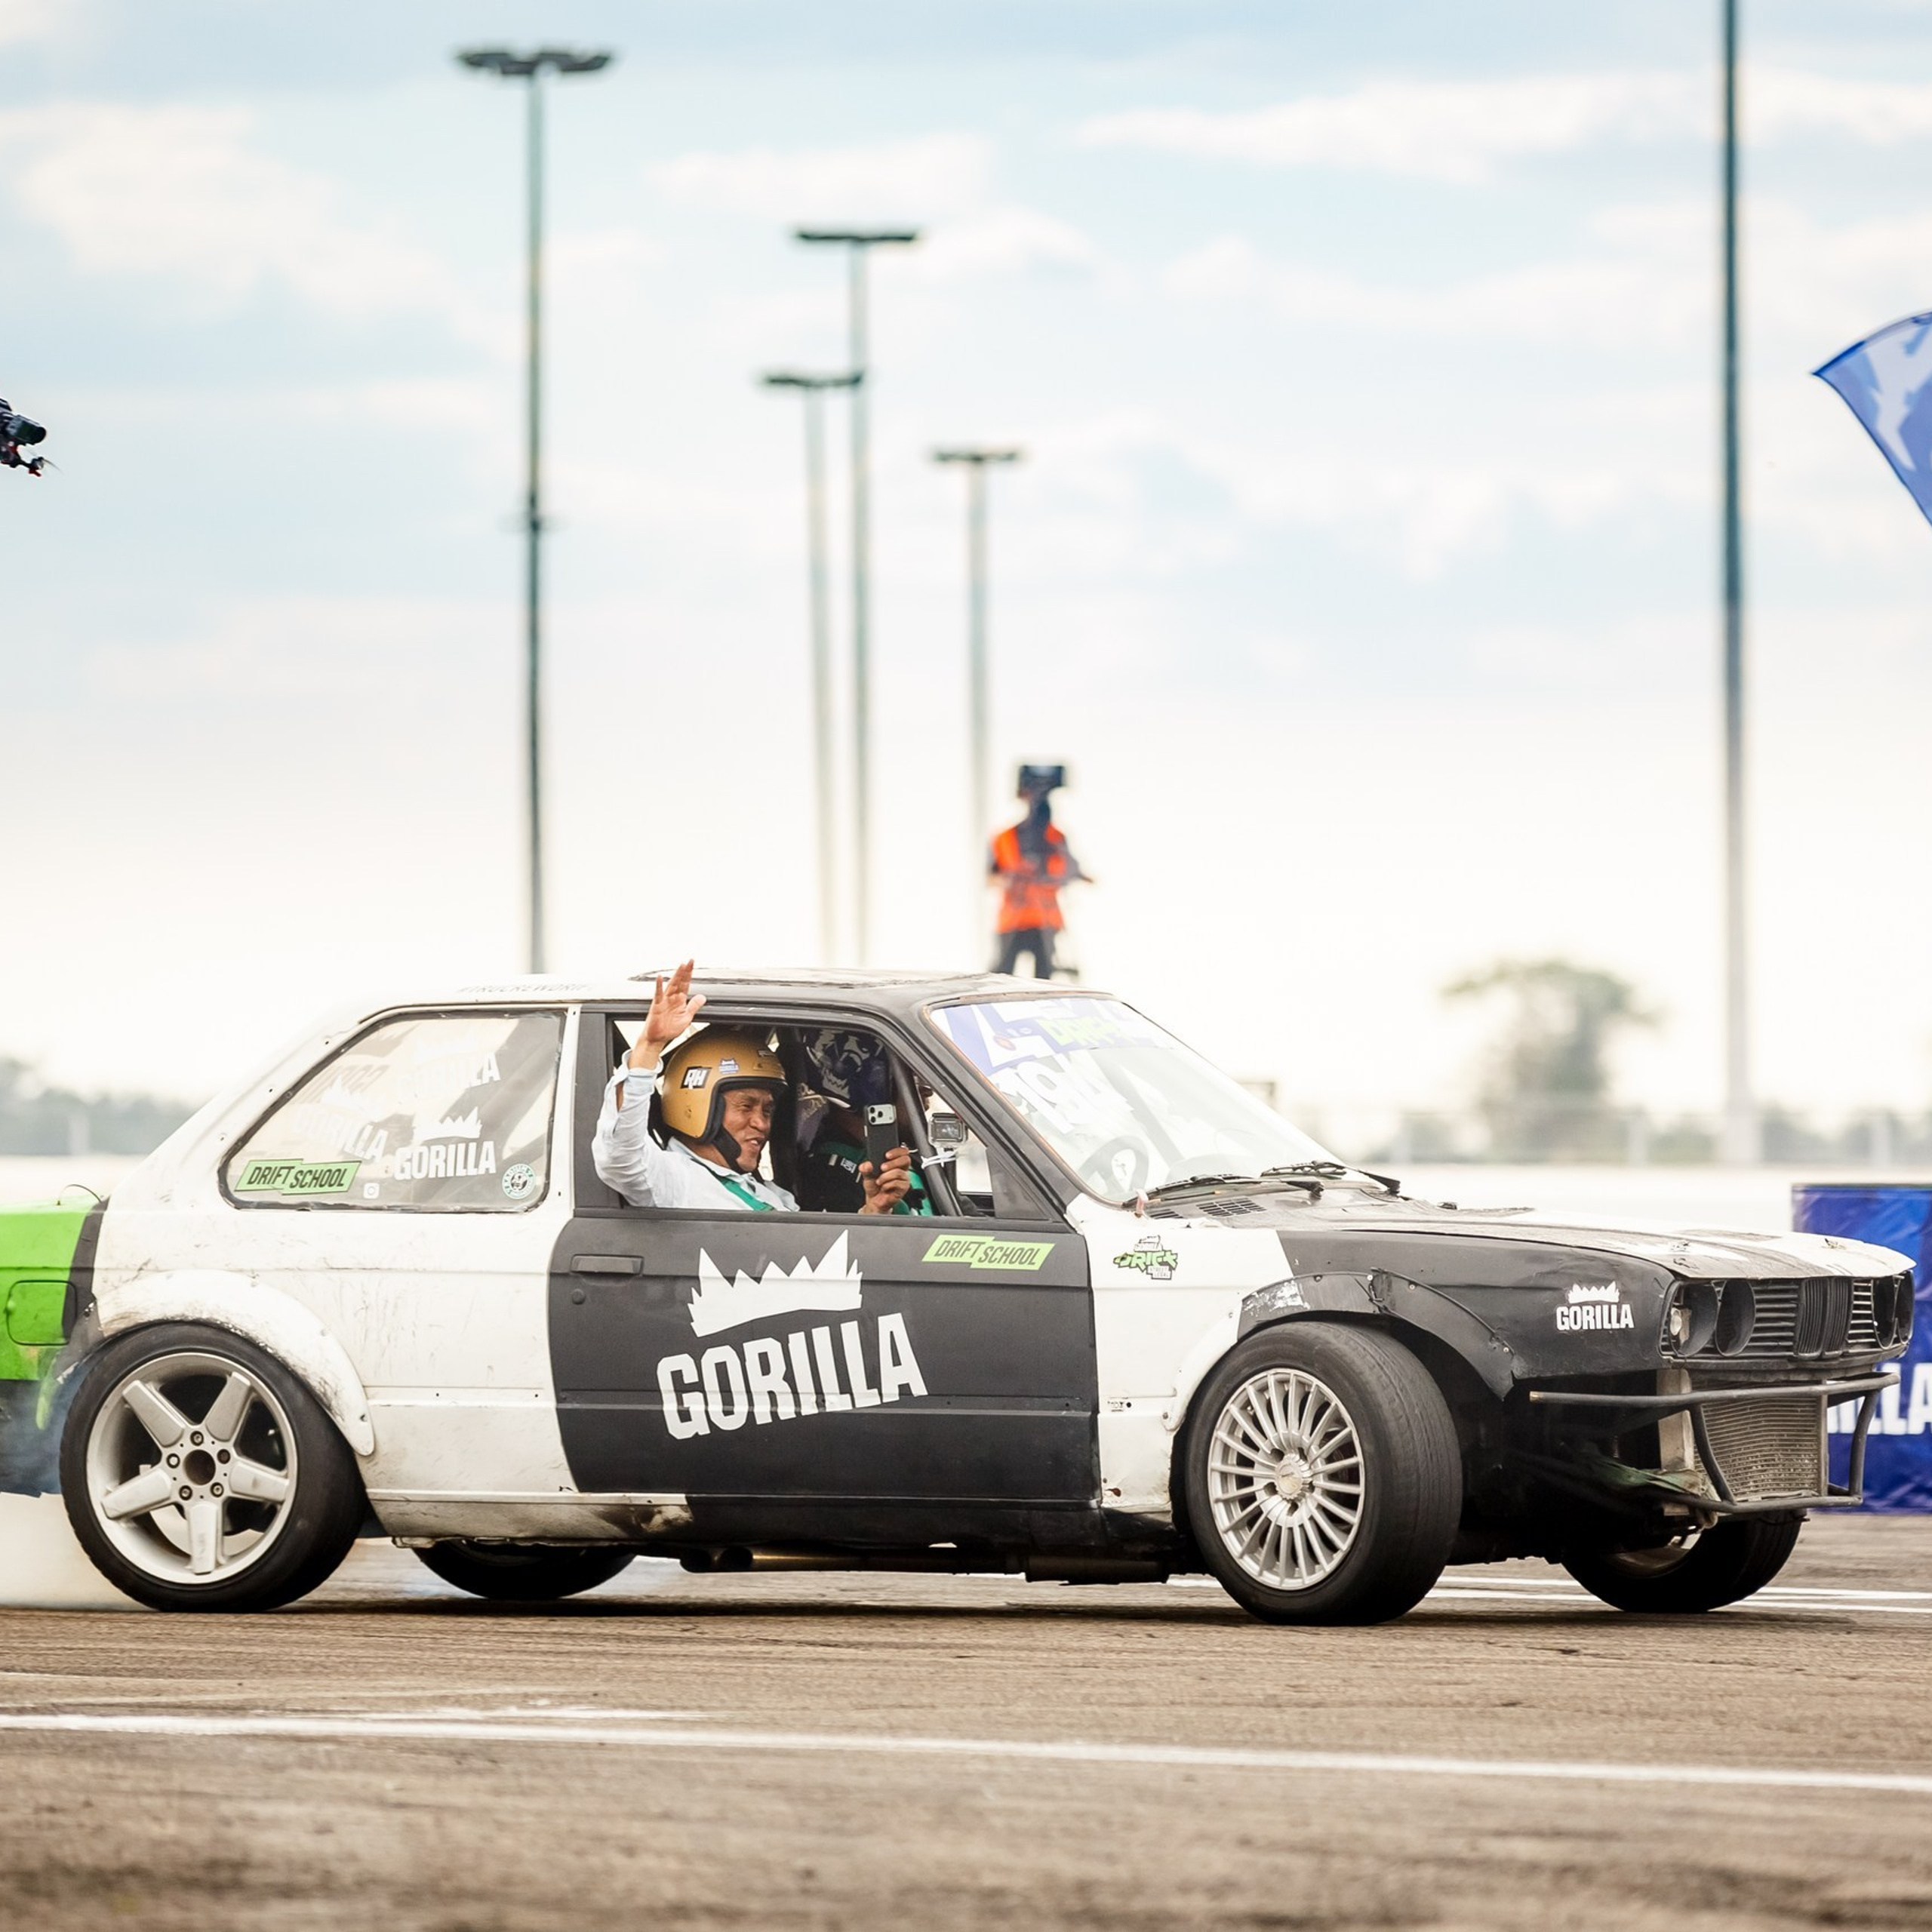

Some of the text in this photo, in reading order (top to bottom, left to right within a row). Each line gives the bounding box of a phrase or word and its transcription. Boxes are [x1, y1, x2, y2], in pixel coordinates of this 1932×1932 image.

[395, 1141, 496, 1180] GORILLA
[247, 1166, 347, 1189] DRIFT SCHOOL
[934, 1240, 1041, 1266] DRIFT SCHOOL
[1556, 1303, 1635, 1331] GORILLA
[657, 1312, 928, 1440] GORILLA
